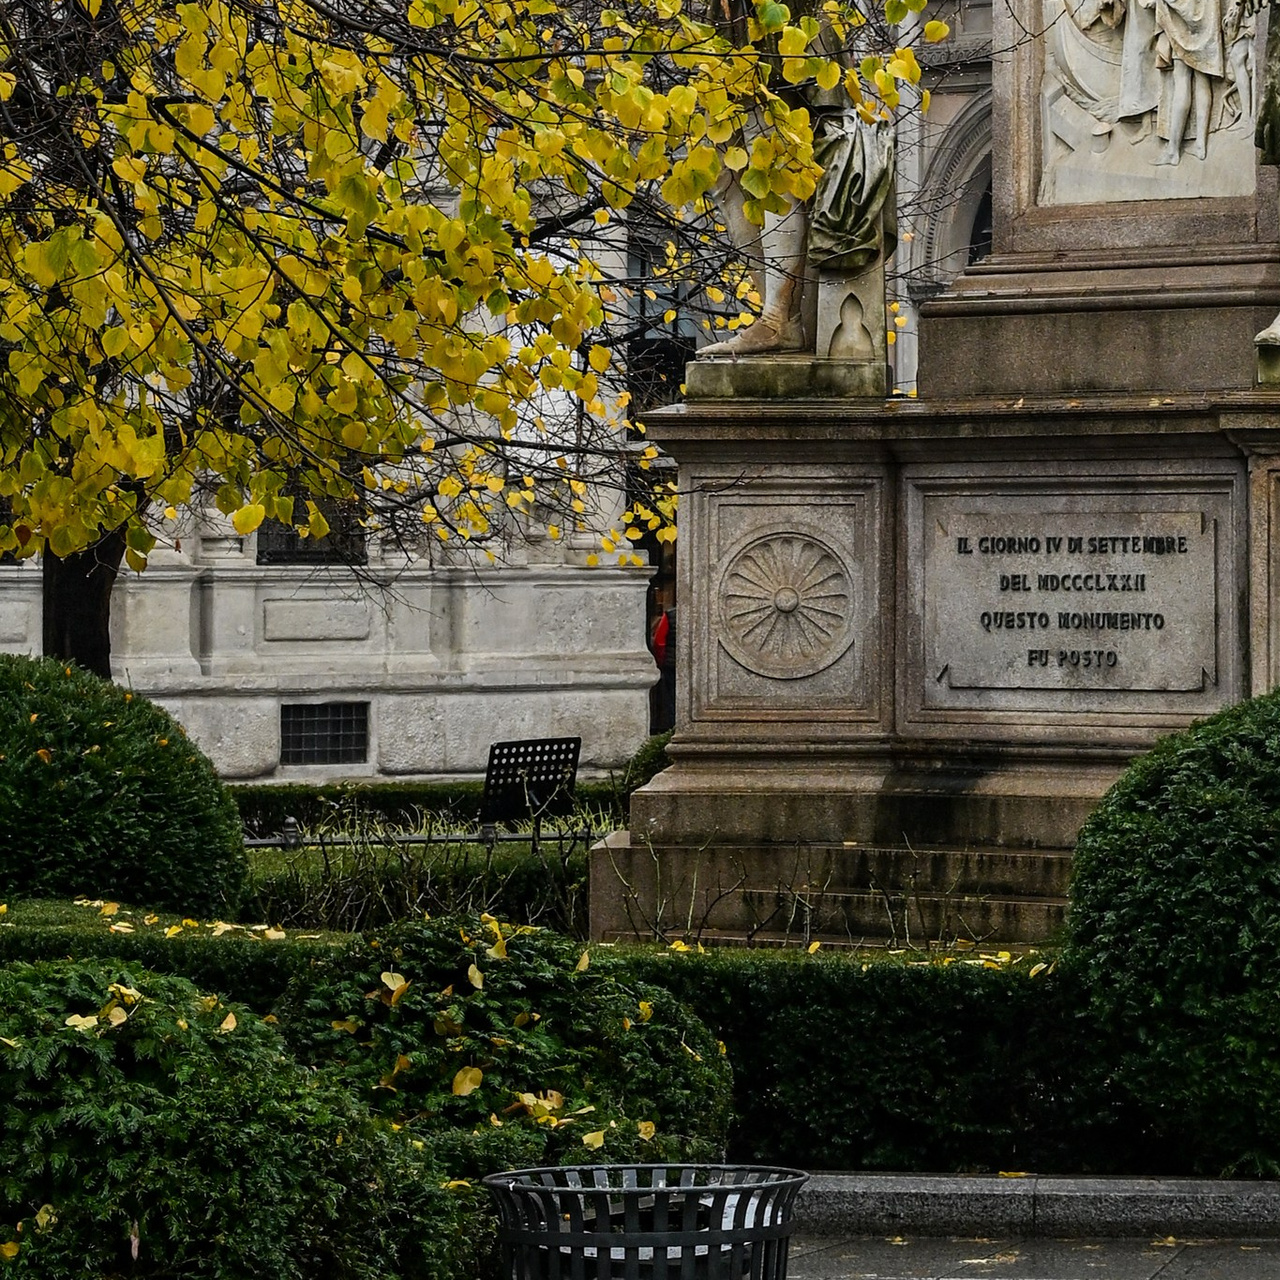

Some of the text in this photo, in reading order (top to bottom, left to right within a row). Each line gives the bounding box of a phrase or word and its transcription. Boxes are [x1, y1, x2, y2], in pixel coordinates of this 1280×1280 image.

[957, 536, 1188, 555] IL GIORNO IV DI SETTEMBRE
[1000, 574, 1146, 591] DEL MDCCCLXXII
[980, 611, 1165, 632] QUESTO MONUMENTO
[1027, 649, 1118, 667] FU POSTO
